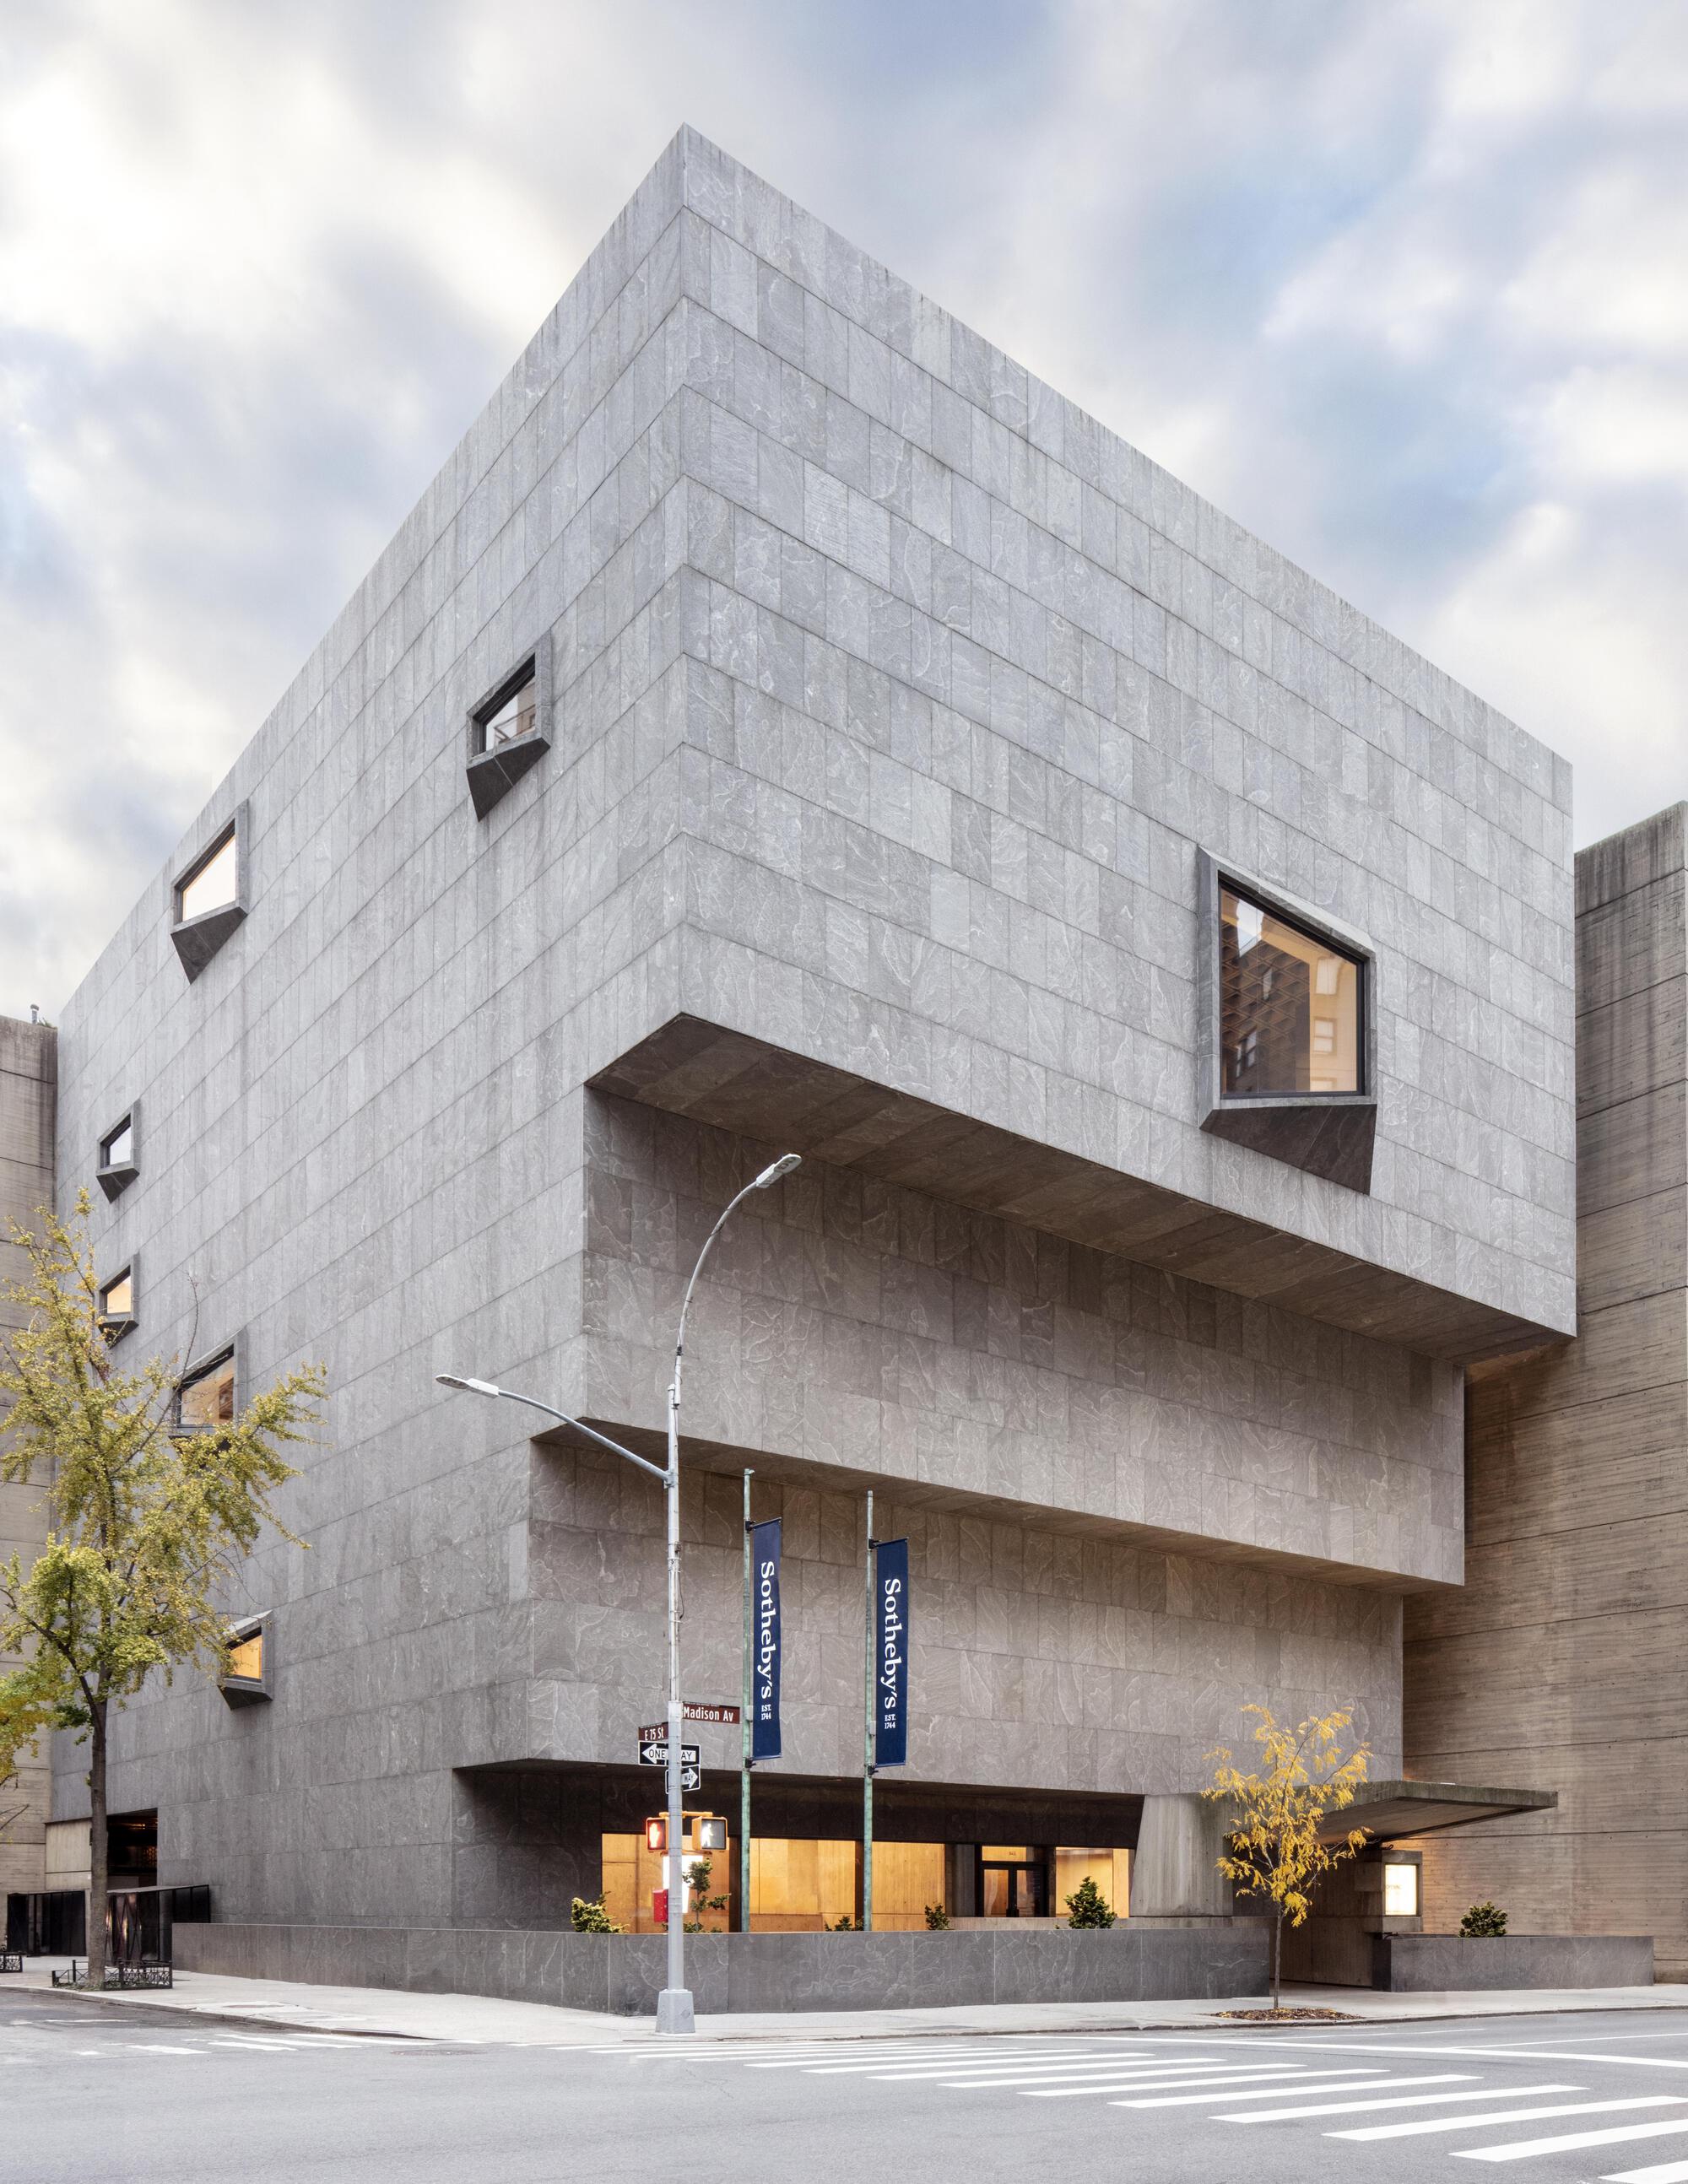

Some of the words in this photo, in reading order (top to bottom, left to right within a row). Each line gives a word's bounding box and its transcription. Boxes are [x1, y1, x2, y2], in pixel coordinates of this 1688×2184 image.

[757, 1561, 776, 1699] Sotheby's
[880, 1578, 902, 1709] Sotheby's
[684, 1706, 720, 1721] Madison
[722, 1710, 733, 1722] Av
[644, 1730, 648, 1741] E
[649, 1728, 657, 1740] 75
[657, 1727, 664, 1738] St
[648, 1749, 666, 1759] ONE
[681, 1751, 692, 1760] AY
